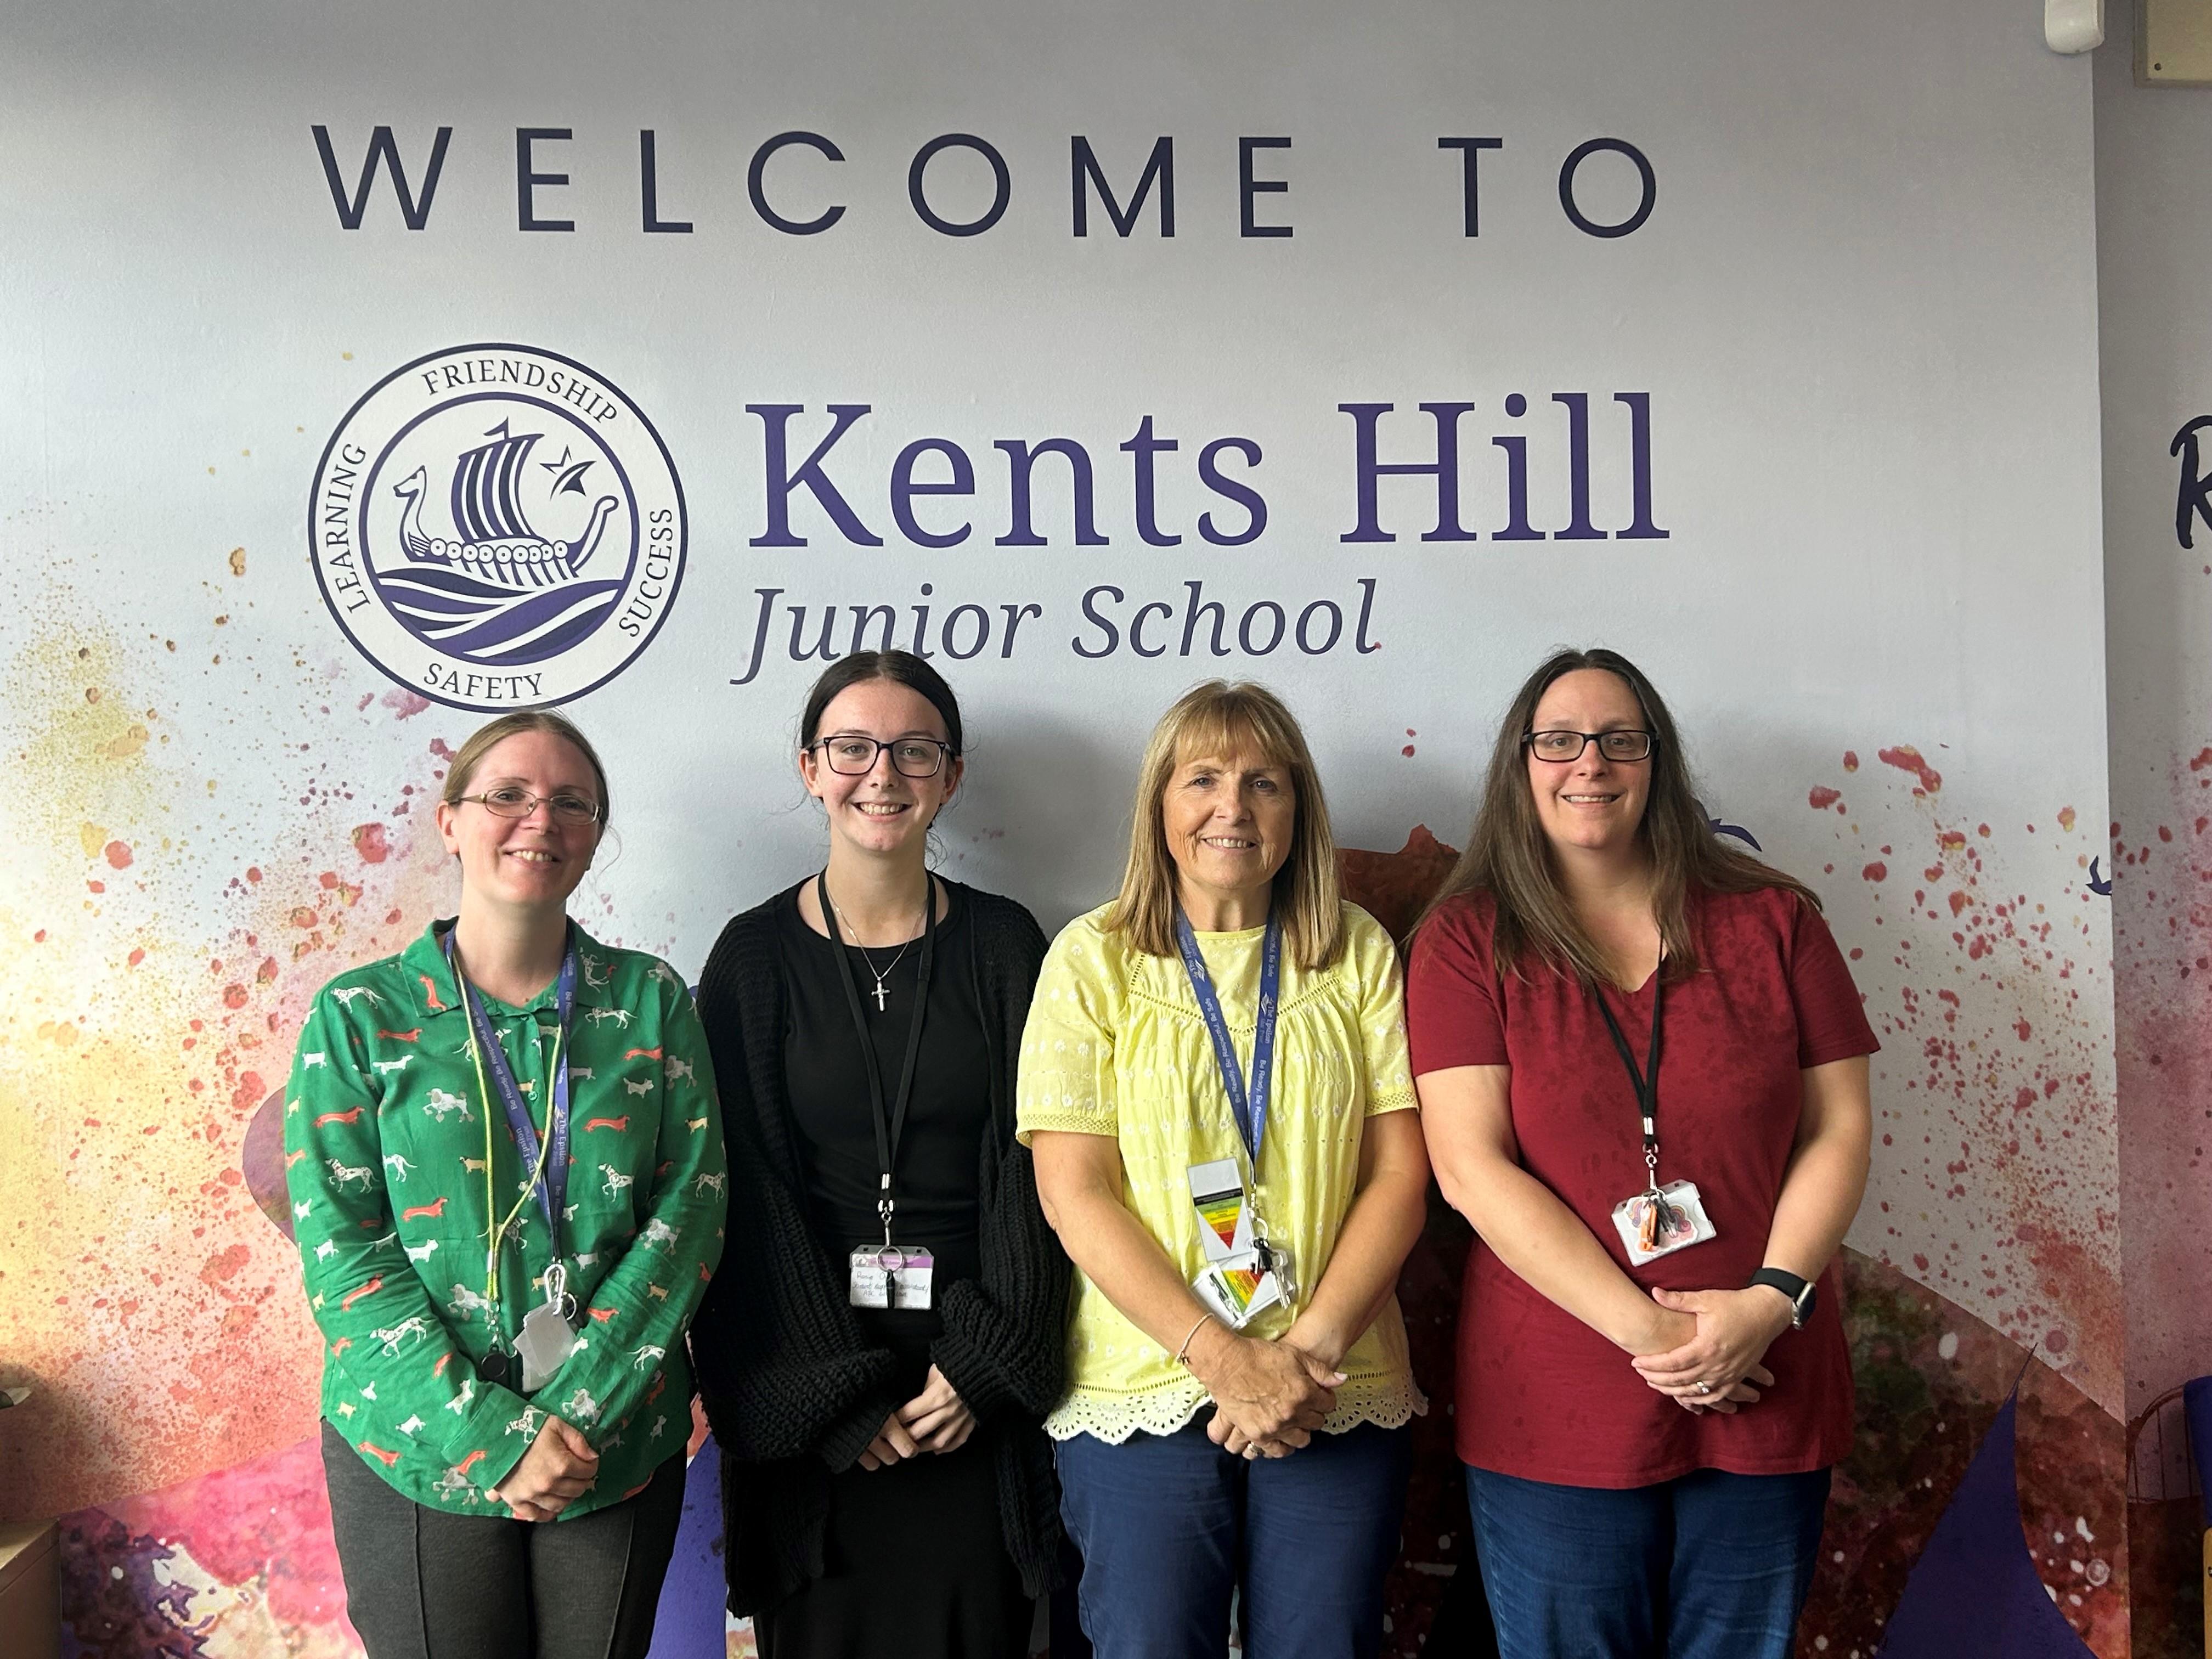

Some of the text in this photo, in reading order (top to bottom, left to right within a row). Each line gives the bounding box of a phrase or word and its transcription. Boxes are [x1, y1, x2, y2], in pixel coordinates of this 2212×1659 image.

[312, 126, 1656, 238] WELCOME TO
[421, 359, 618, 424] FRIENDSHIP
[746, 393, 1669, 548] Kents Hill
[325, 444, 370, 613] LEARNING
[619, 510, 672, 637] SUCCESS
[424, 663, 543, 699] SAFETY
[730, 579, 1377, 684] Junior School
